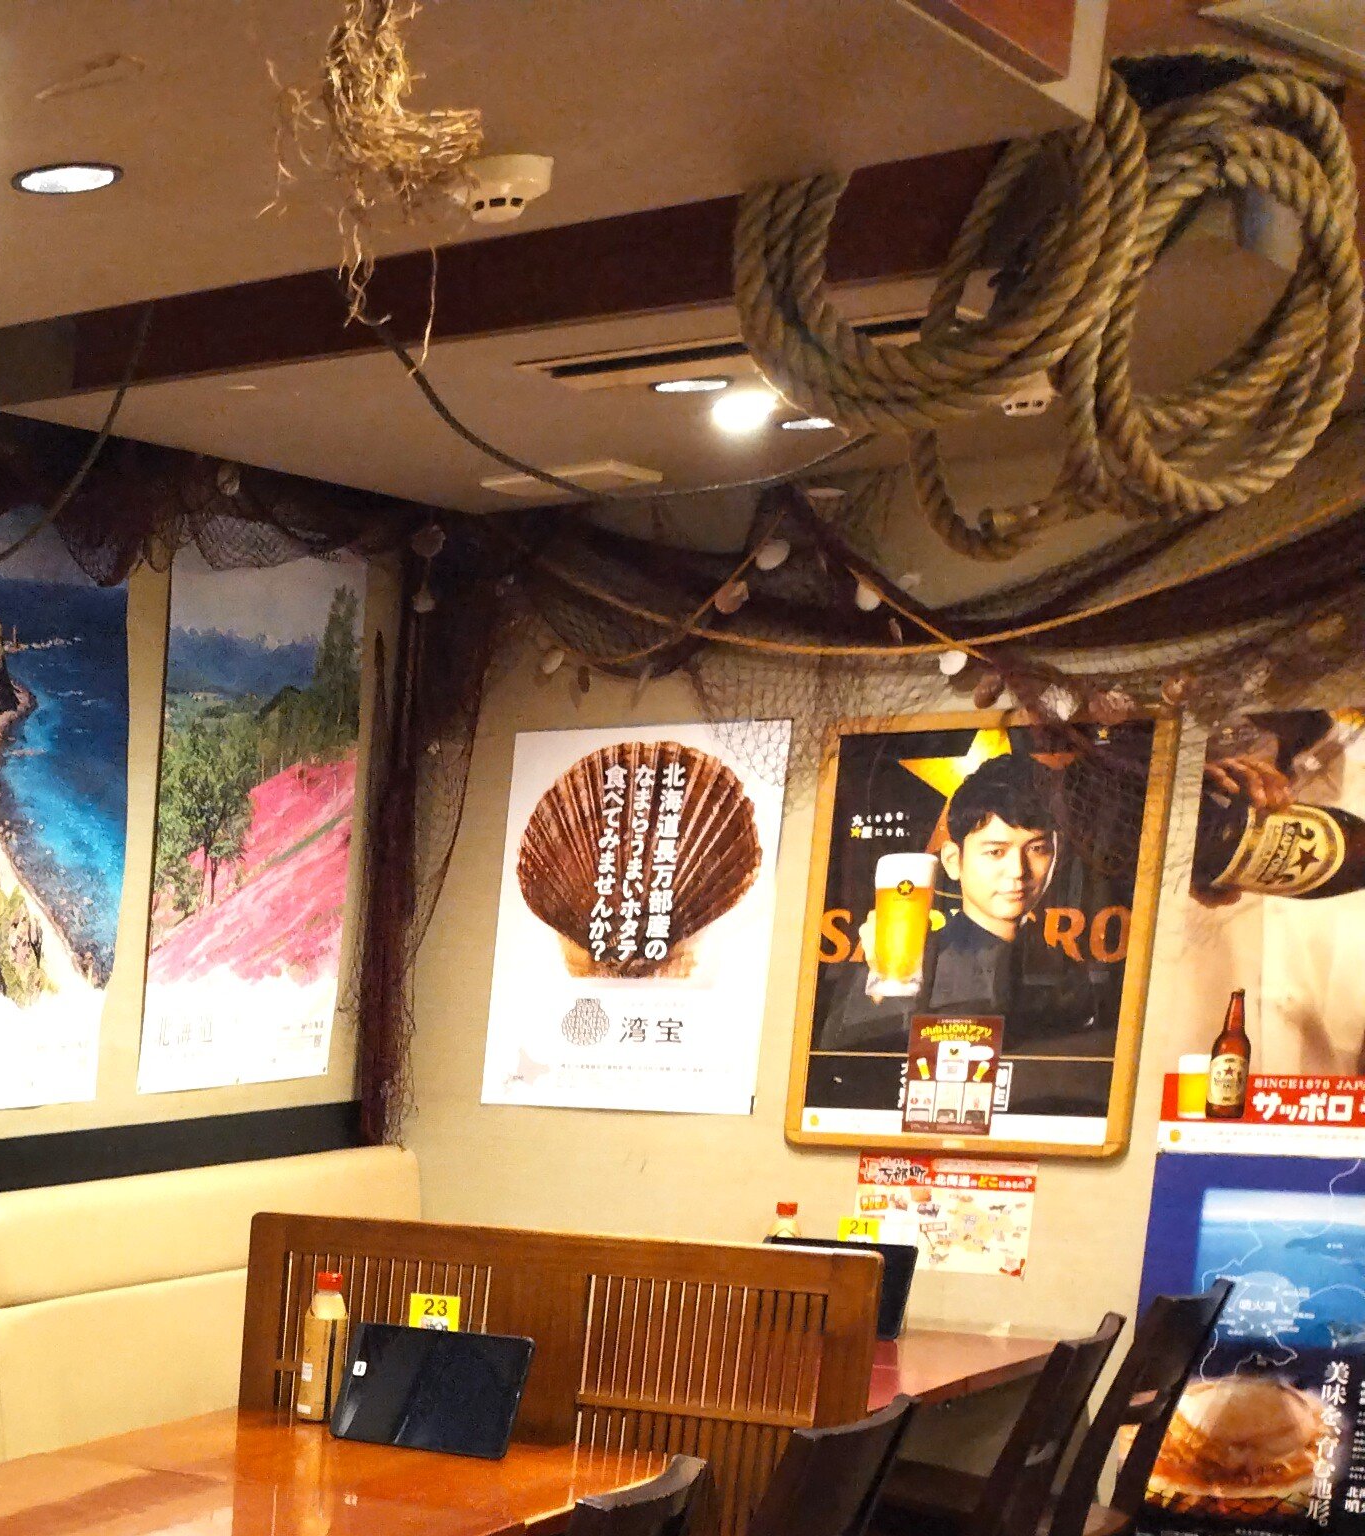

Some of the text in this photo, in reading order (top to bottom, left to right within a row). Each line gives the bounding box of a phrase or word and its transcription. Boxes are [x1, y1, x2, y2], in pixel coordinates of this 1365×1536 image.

[589, 764, 628, 961] 食べてみませんか？
[617, 764, 656, 961] なまらうまいホタテ
[644, 761, 686, 961] 北海道長万部産の
[619, 1016, 684, 1043] 湾宝
[849, 1221, 869, 1234] 21
[423, 1298, 448, 1316] 23
